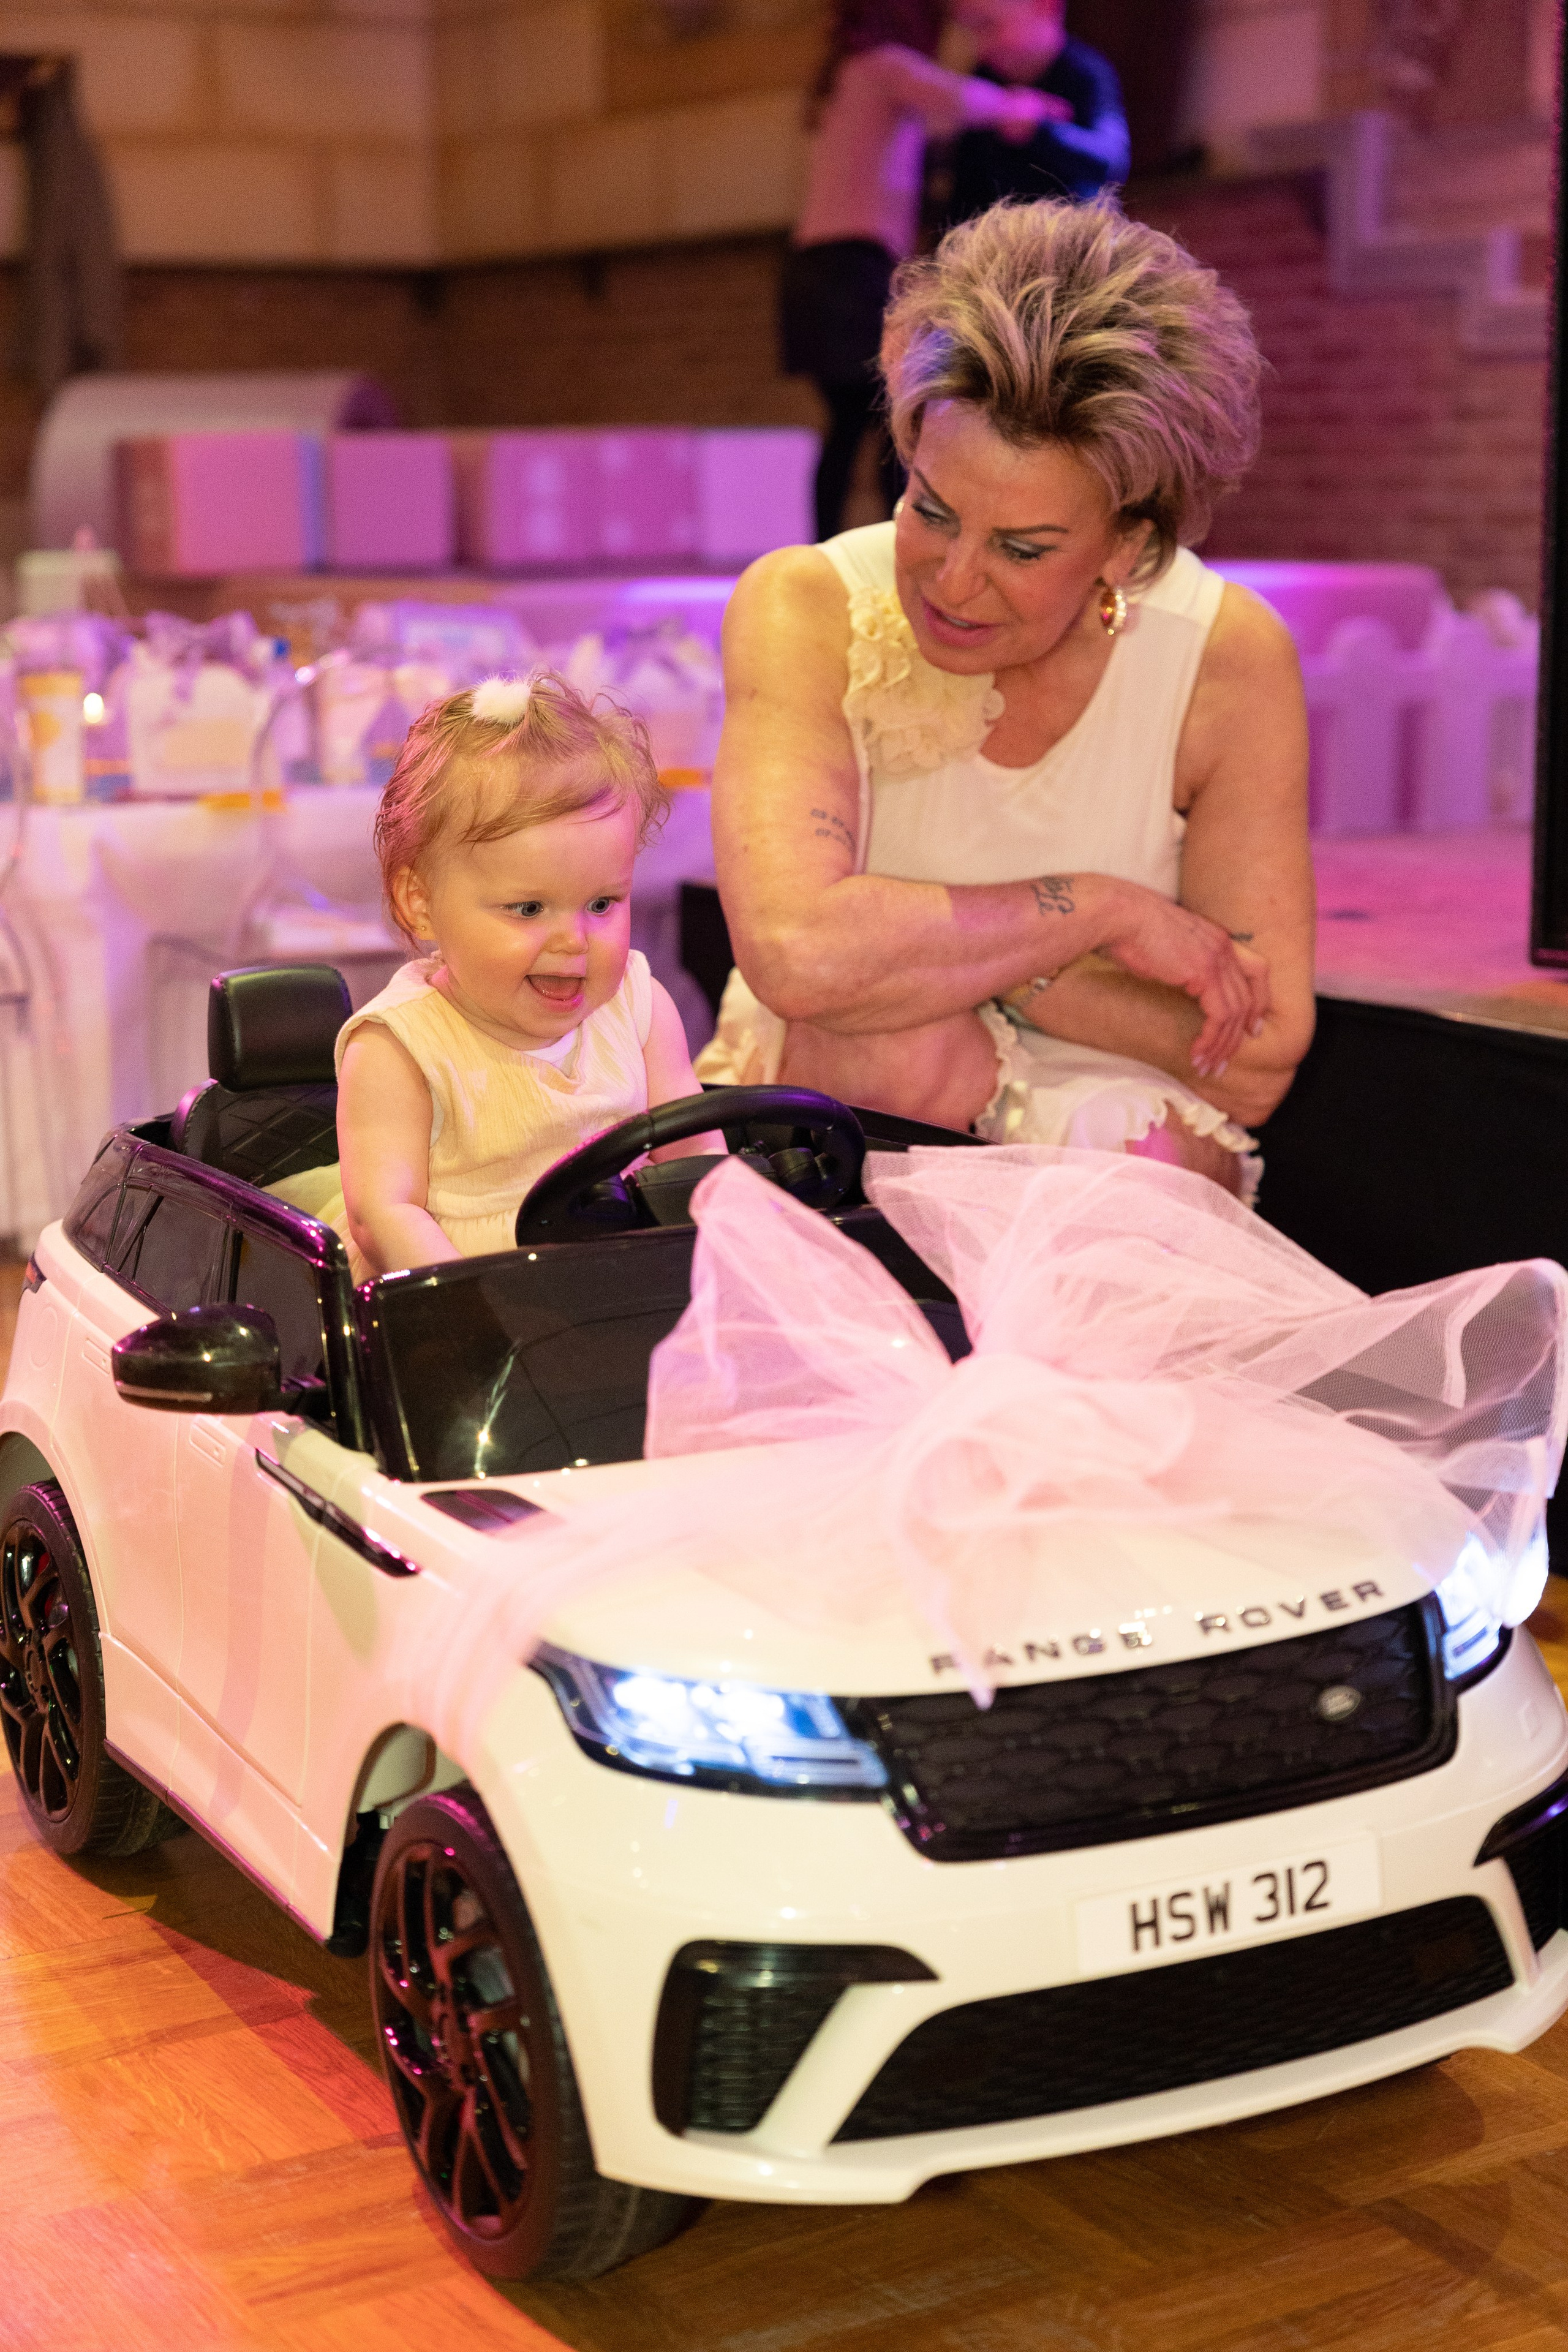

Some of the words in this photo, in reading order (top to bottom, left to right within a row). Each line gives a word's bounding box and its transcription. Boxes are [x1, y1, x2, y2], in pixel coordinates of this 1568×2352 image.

[1198, 1580, 1384, 1637] ROVER
[1129, 1880, 1231, 1952] HSW
[1253, 1860, 1330, 1923] 312
